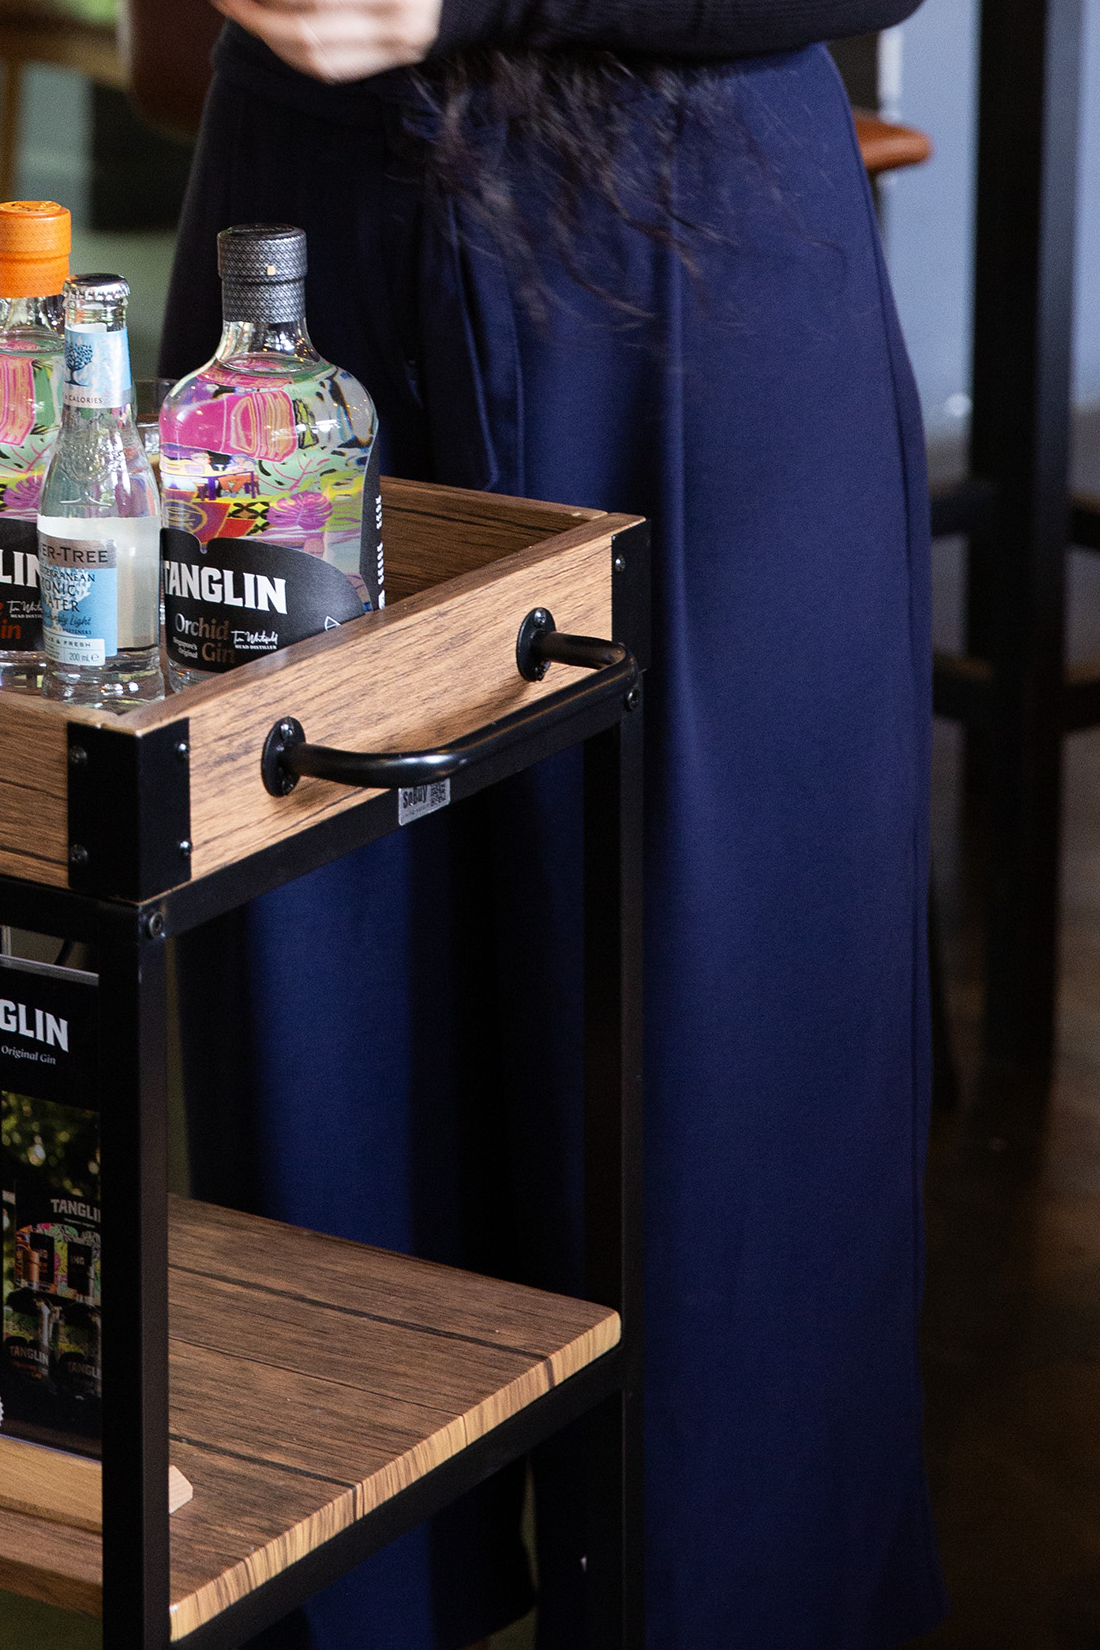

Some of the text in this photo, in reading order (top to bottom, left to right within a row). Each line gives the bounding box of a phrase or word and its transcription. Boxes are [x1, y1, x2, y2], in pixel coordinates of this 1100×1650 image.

[69, 395, 103, 403] CALORIES
[42, 543, 108, 563] ER-TREE
[164, 560, 288, 615] TANGLIN
[46, 596, 80, 612] ATER
[70, 615, 92, 628] Light
[175, 613, 230, 641] Orchid
[63, 640, 91, 648] FRESH
[202, 642, 235, 663] Gin
[69, 652, 80, 661] 200
[1, 1044, 38, 1061] Original
[39, 1054, 56, 1066] Gin
[49, 1198, 101, 1223] TANGLI
